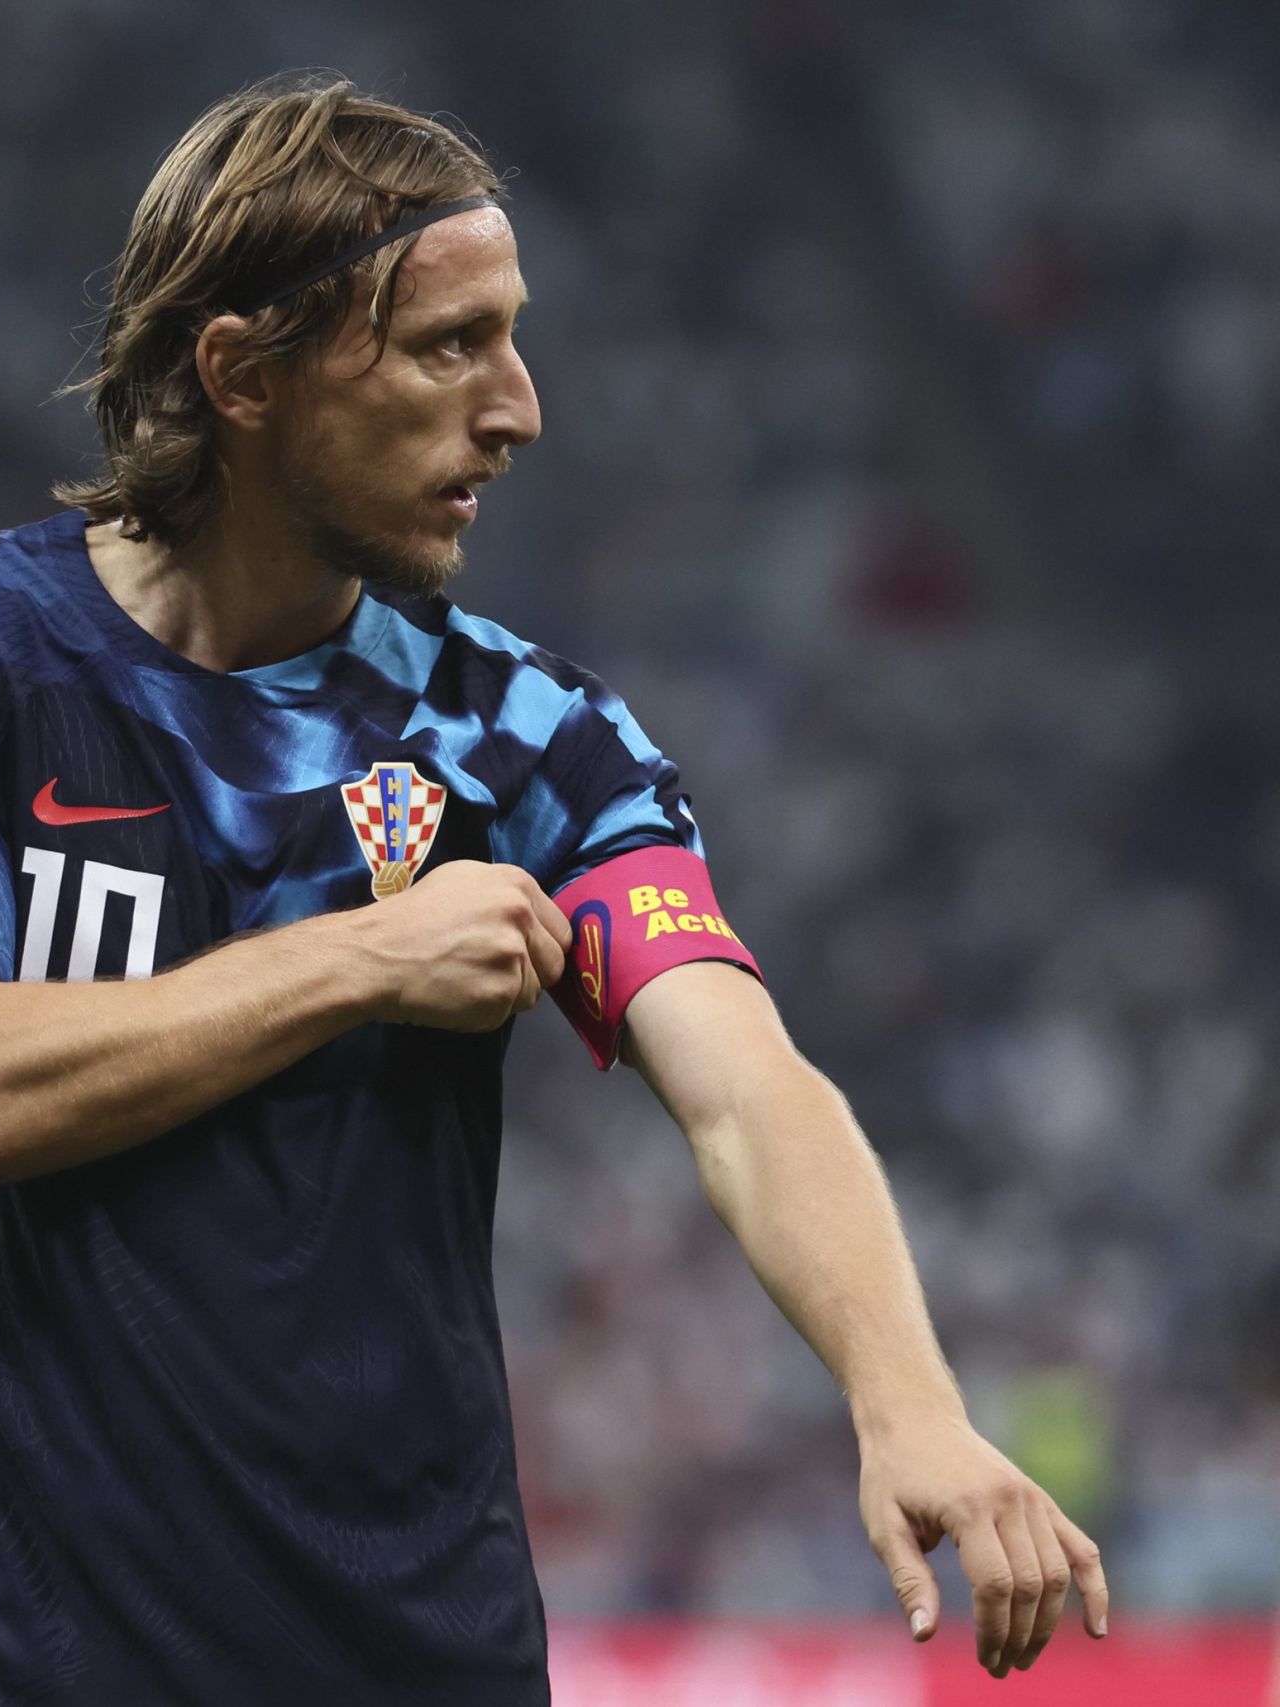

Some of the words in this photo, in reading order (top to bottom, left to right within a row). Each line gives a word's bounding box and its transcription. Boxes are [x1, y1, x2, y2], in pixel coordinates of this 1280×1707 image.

[387, 777, 403, 847] HNS
[20, 846, 165, 984] 10
[628, 885, 688, 917] Be
[645, 910, 744, 943] Acti
